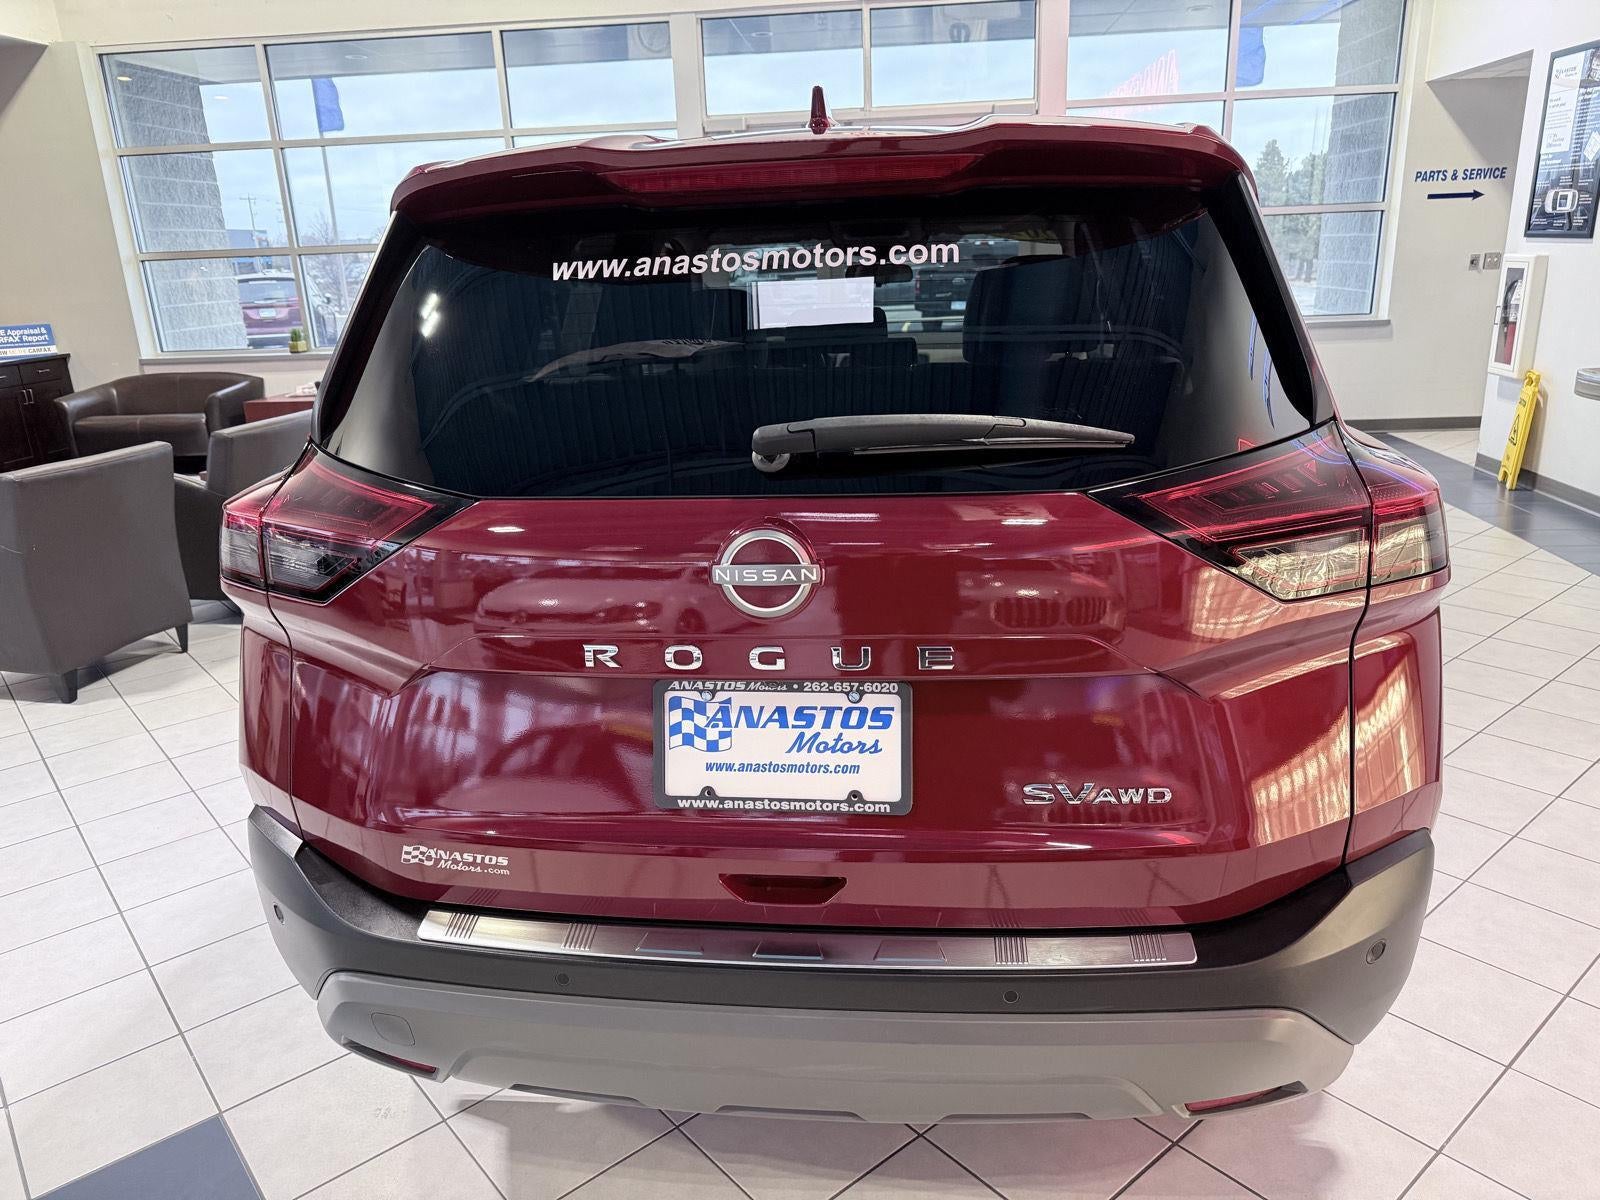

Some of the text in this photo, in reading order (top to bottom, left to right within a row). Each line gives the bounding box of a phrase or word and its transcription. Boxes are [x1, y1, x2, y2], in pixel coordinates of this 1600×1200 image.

[1415, 167, 1508, 182] PARTS & SERVICE
[552, 243, 960, 281] www.anastosmotors.com
[7, 328, 40, 336] Appraisal
[22, 334, 48, 342] Report
[715, 568, 817, 582] NISSAN
[582, 644, 954, 671] ROGUE
[668, 681, 746, 691] ANASTOS
[803, 682, 899, 693] 262-657-6020
[704, 704, 895, 730] ANASTOS
[785, 731, 883, 755] Motors
[705, 761, 860, 774] www.anastosmotors.com
[677, 799, 890, 813] www.anastosmotors.com
[424, 848, 509, 866] ANASTOS
